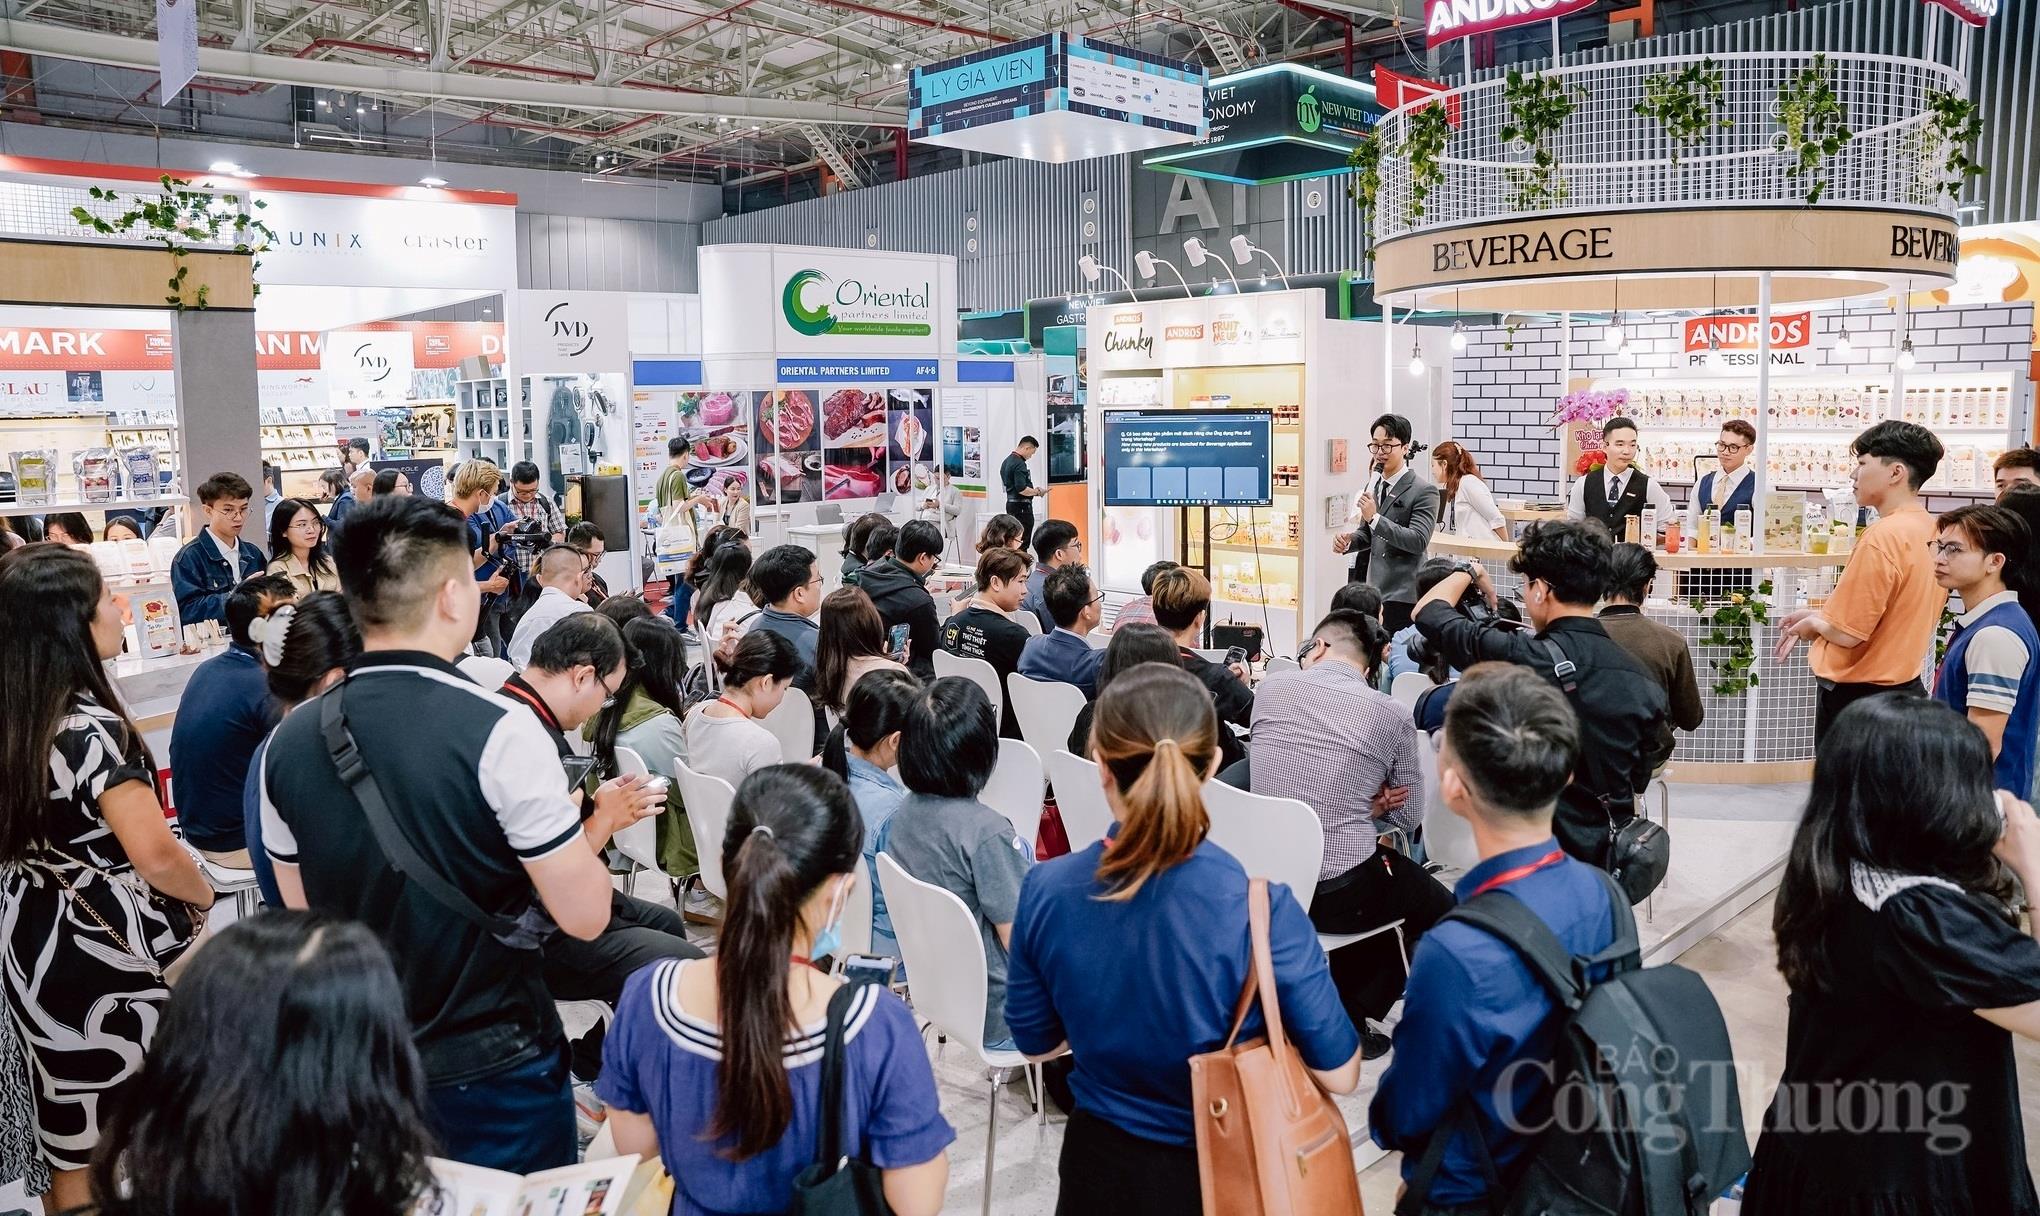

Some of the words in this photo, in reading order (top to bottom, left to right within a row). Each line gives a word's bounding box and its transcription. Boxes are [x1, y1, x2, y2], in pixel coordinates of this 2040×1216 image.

[931, 76, 952, 99] LY
[956, 68, 986, 92] GIA
[1321, 100, 1343, 116] NEW
[1343, 104, 1363, 122] VIET
[1432, 227, 1614, 272] BEVERAGE
[835, 278, 929, 308] Oriental
[1068, 300, 1087, 310] NEW
[841, 310, 889, 321] partners
[893, 309, 928, 321] limited
[551, 320, 590, 338] JVD
[1166, 327, 1202, 338] ANDROS
[1104, 326, 1154, 359] Chunky
[359, 356, 388, 368] JVD
[780, 366, 819, 377] ORIENTAL
[820, 366, 859, 376] PARTNERS
[861, 366, 890, 376] LIMITED
[915, 365, 936, 375] AF4-8
